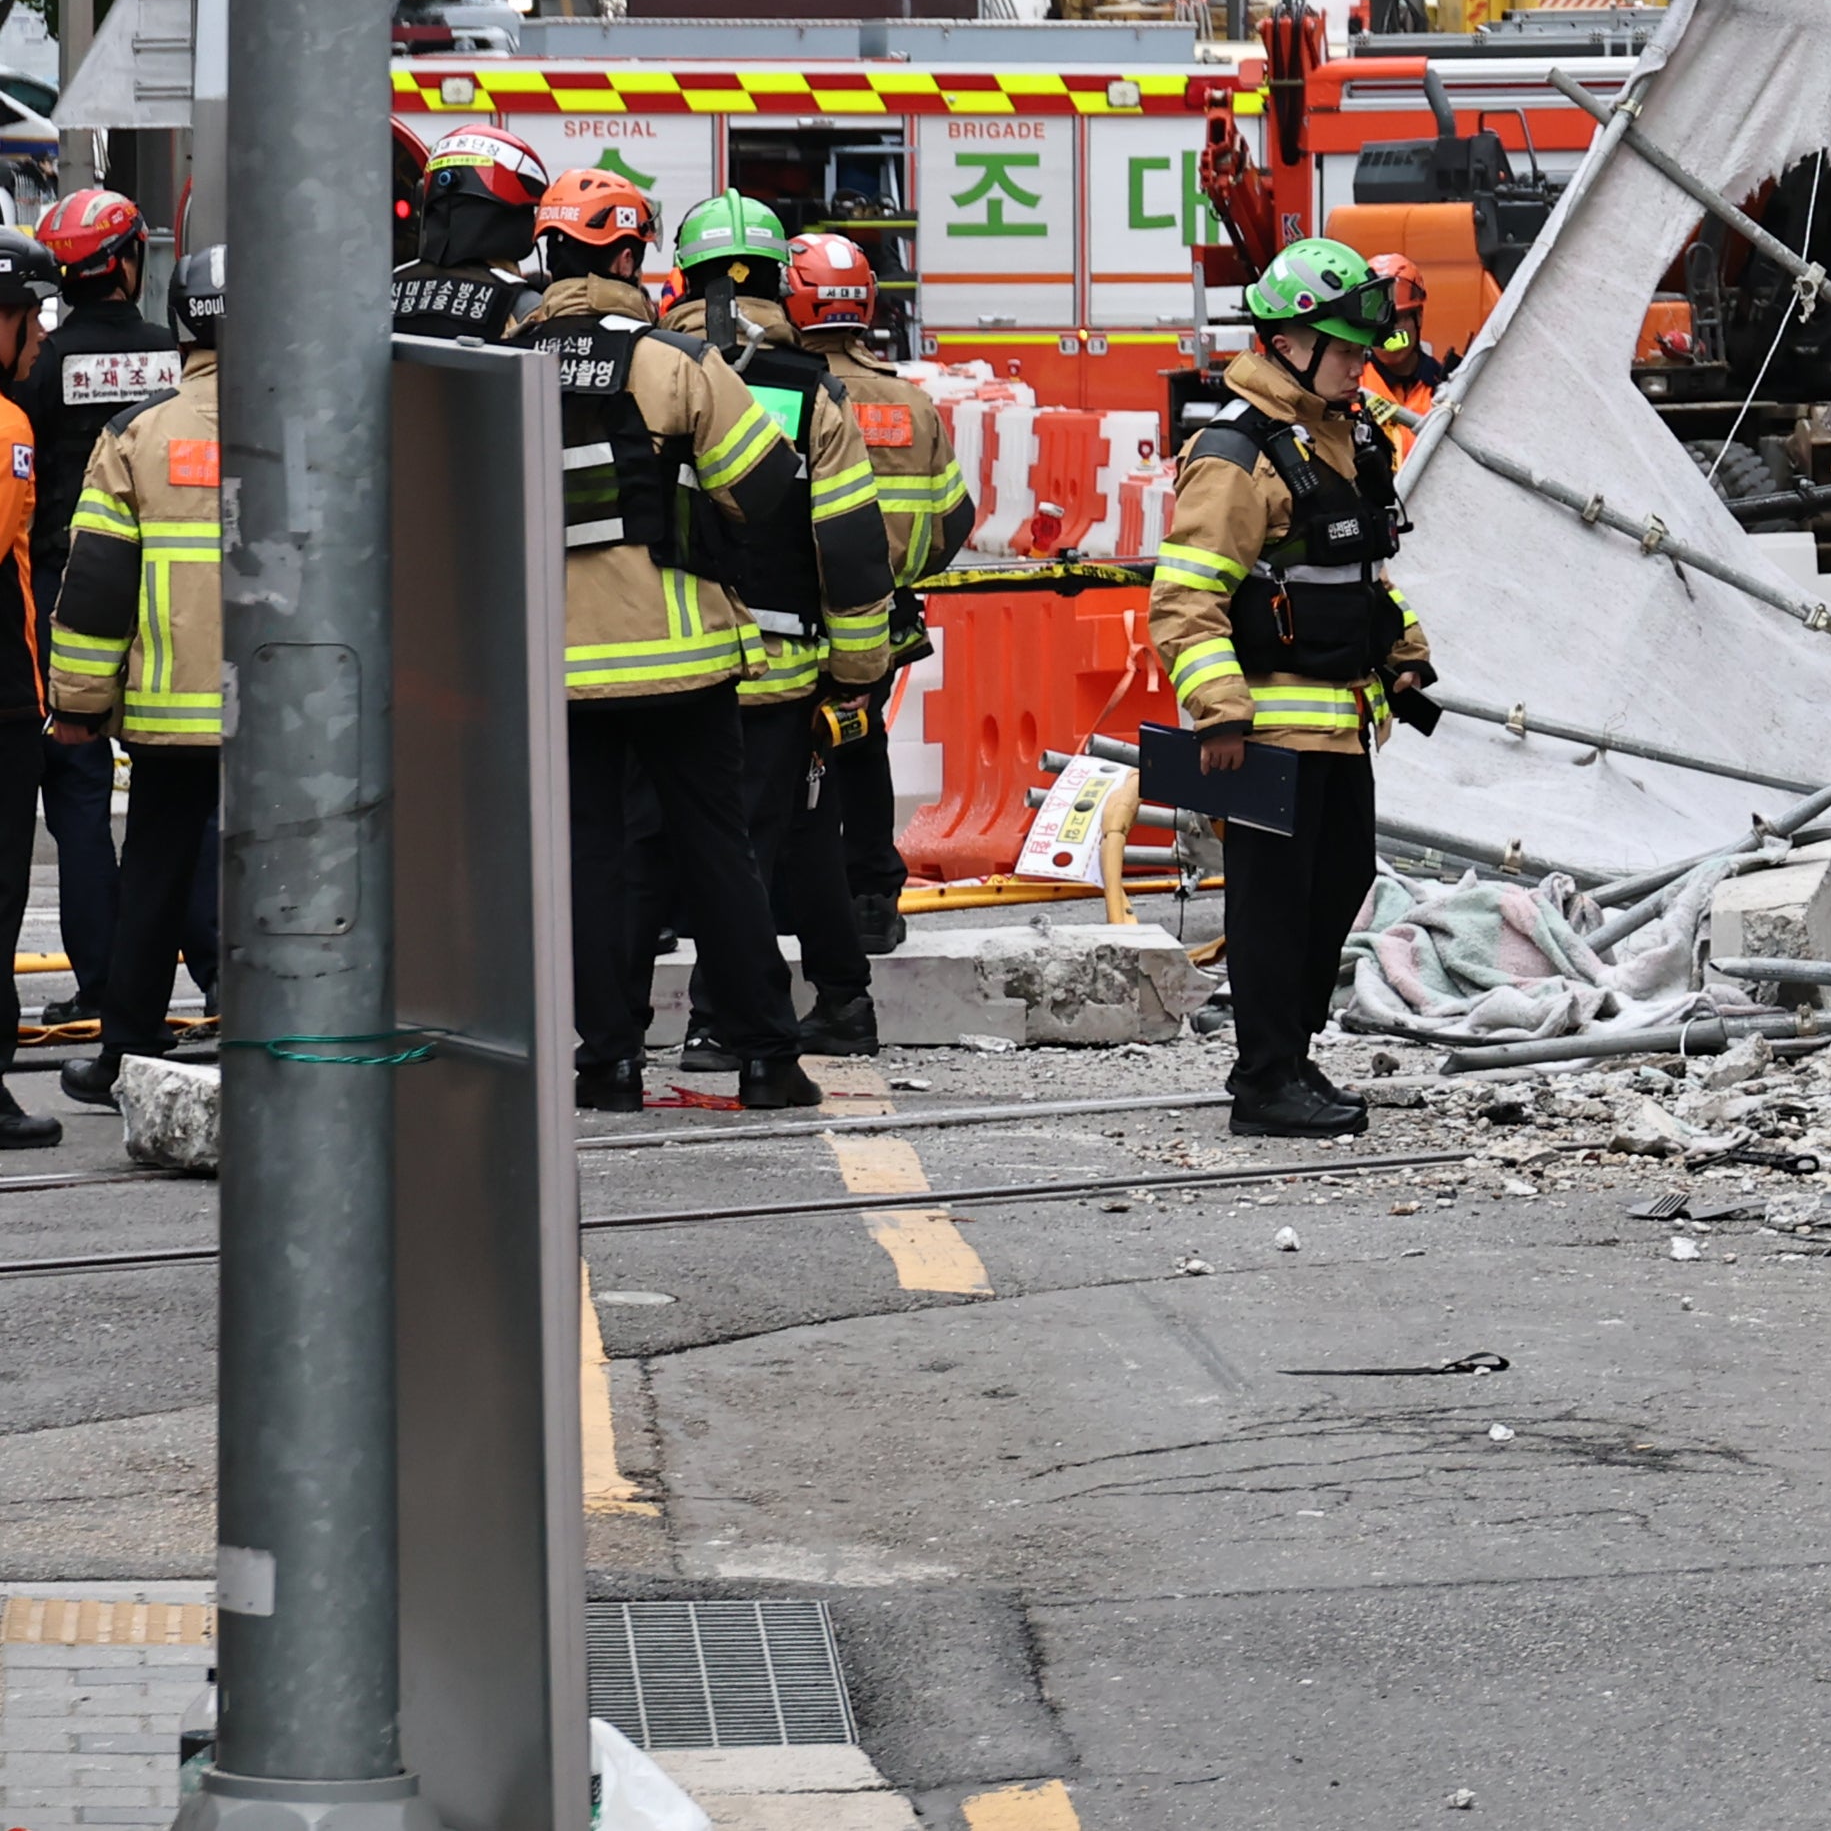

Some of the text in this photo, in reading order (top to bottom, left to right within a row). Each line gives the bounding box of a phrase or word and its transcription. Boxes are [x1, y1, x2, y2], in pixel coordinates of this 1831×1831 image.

[564, 120, 1045, 140] SPECIAL BRIGADE
[826, 288, 862, 300] 서대문
[189, 295, 225, 318] Seoul
[72, 367, 175, 389] 화재조사
